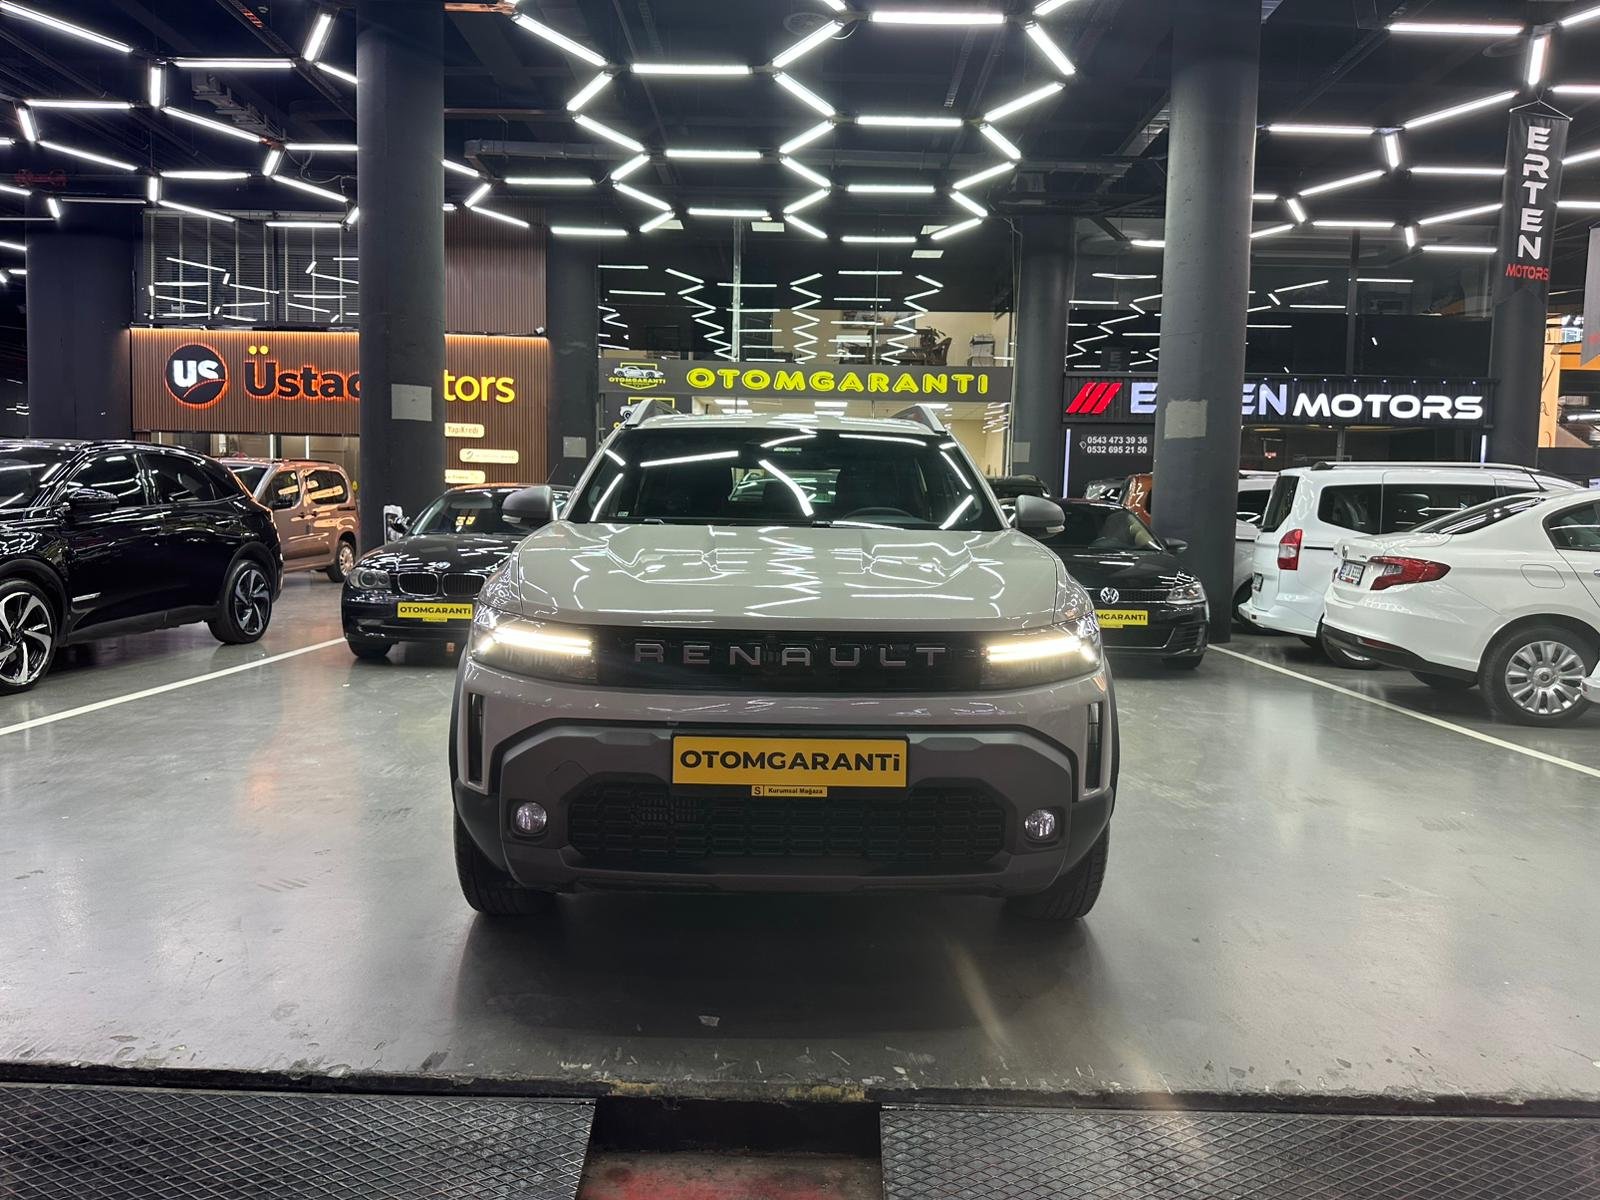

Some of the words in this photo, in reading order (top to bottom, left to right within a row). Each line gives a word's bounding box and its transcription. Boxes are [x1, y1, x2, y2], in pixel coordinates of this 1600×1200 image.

[1517, 125, 1551, 260] ERTEN
[1505, 263, 1550, 281] MOTORS
[686, 367, 989, 395] OTOMGARANTI
[1292, 392, 1484, 420] MOTORS
[1086, 445, 1107, 454] 0532
[1108, 445, 1124, 454] 695
[1125, 445, 1135, 454] 21
[1136, 445, 1147, 454] 50
[1087, 436, 1107, 445] 0543
[1108, 436, 1124, 445] 473
[1125, 436, 1136, 445] 39
[634, 642, 947, 667] RENAULT
[799, 787, 823, 795] Mağaza
